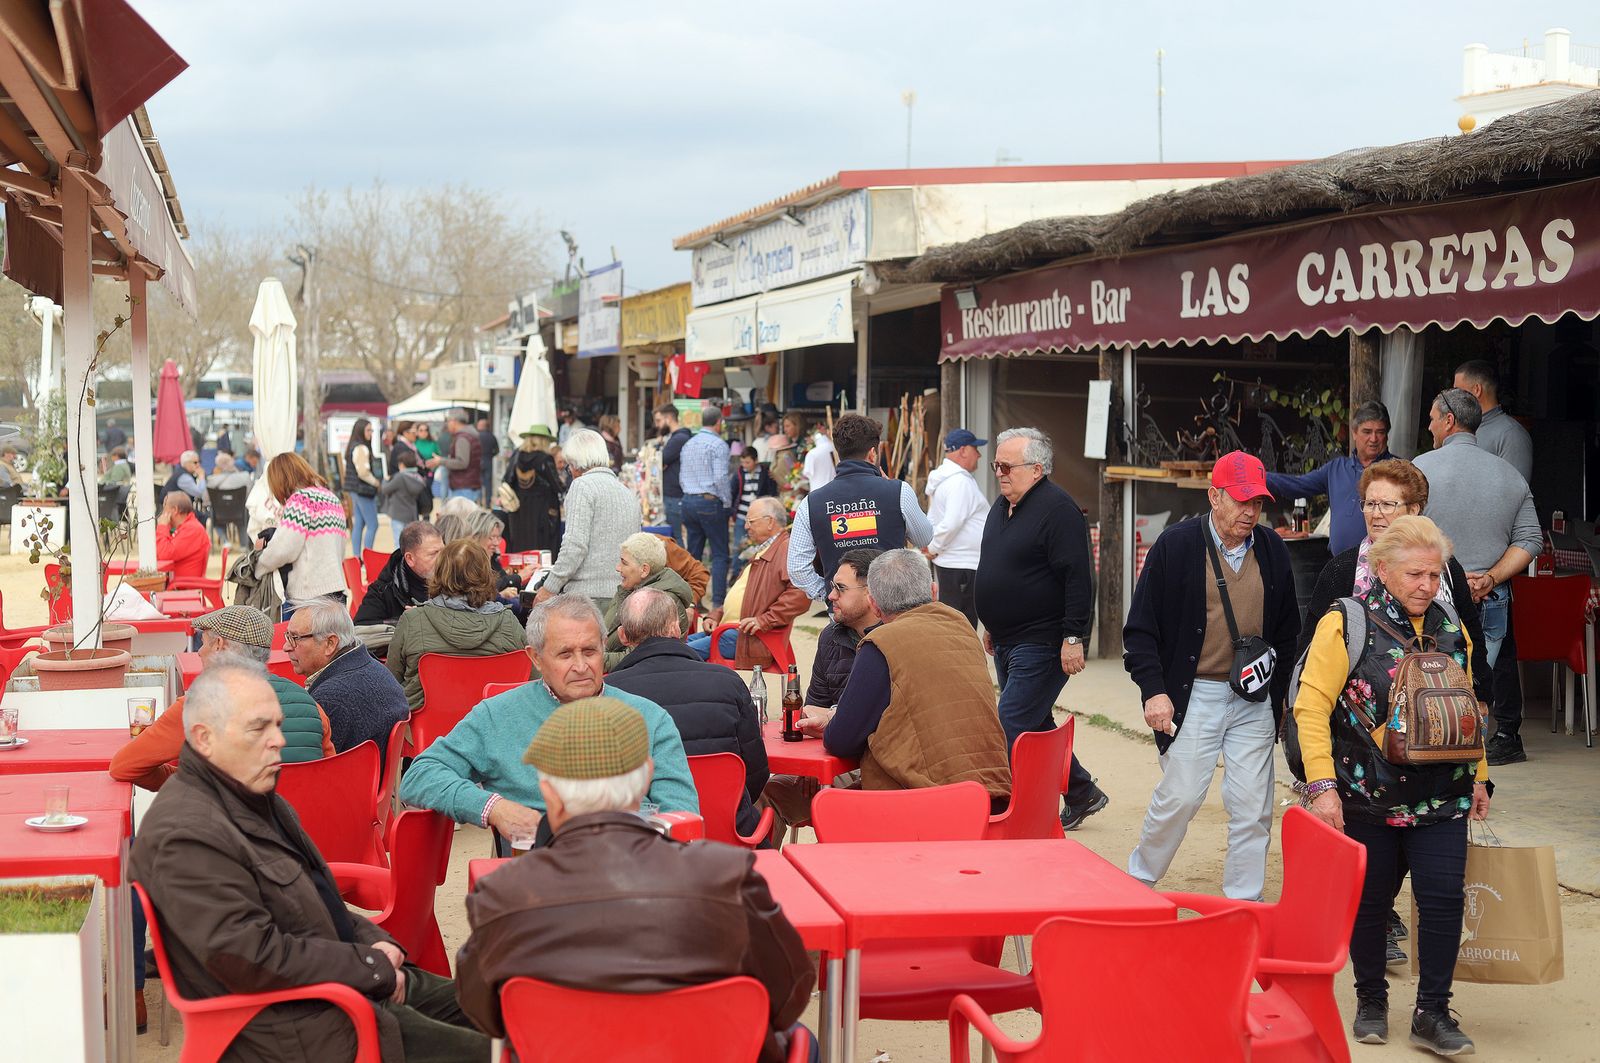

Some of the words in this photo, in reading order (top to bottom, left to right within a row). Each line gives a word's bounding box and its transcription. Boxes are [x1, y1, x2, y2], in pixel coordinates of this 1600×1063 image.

[961, 289, 1072, 340] Restaurante
[1091, 280, 1131, 325] Bar
[1180, 263, 1250, 319] LAS
[1296, 217, 1576, 307] CARRETAS
[825, 498, 877, 516] España
[836, 516, 849, 535] 3
[834, 537, 879, 549] valecuatro
